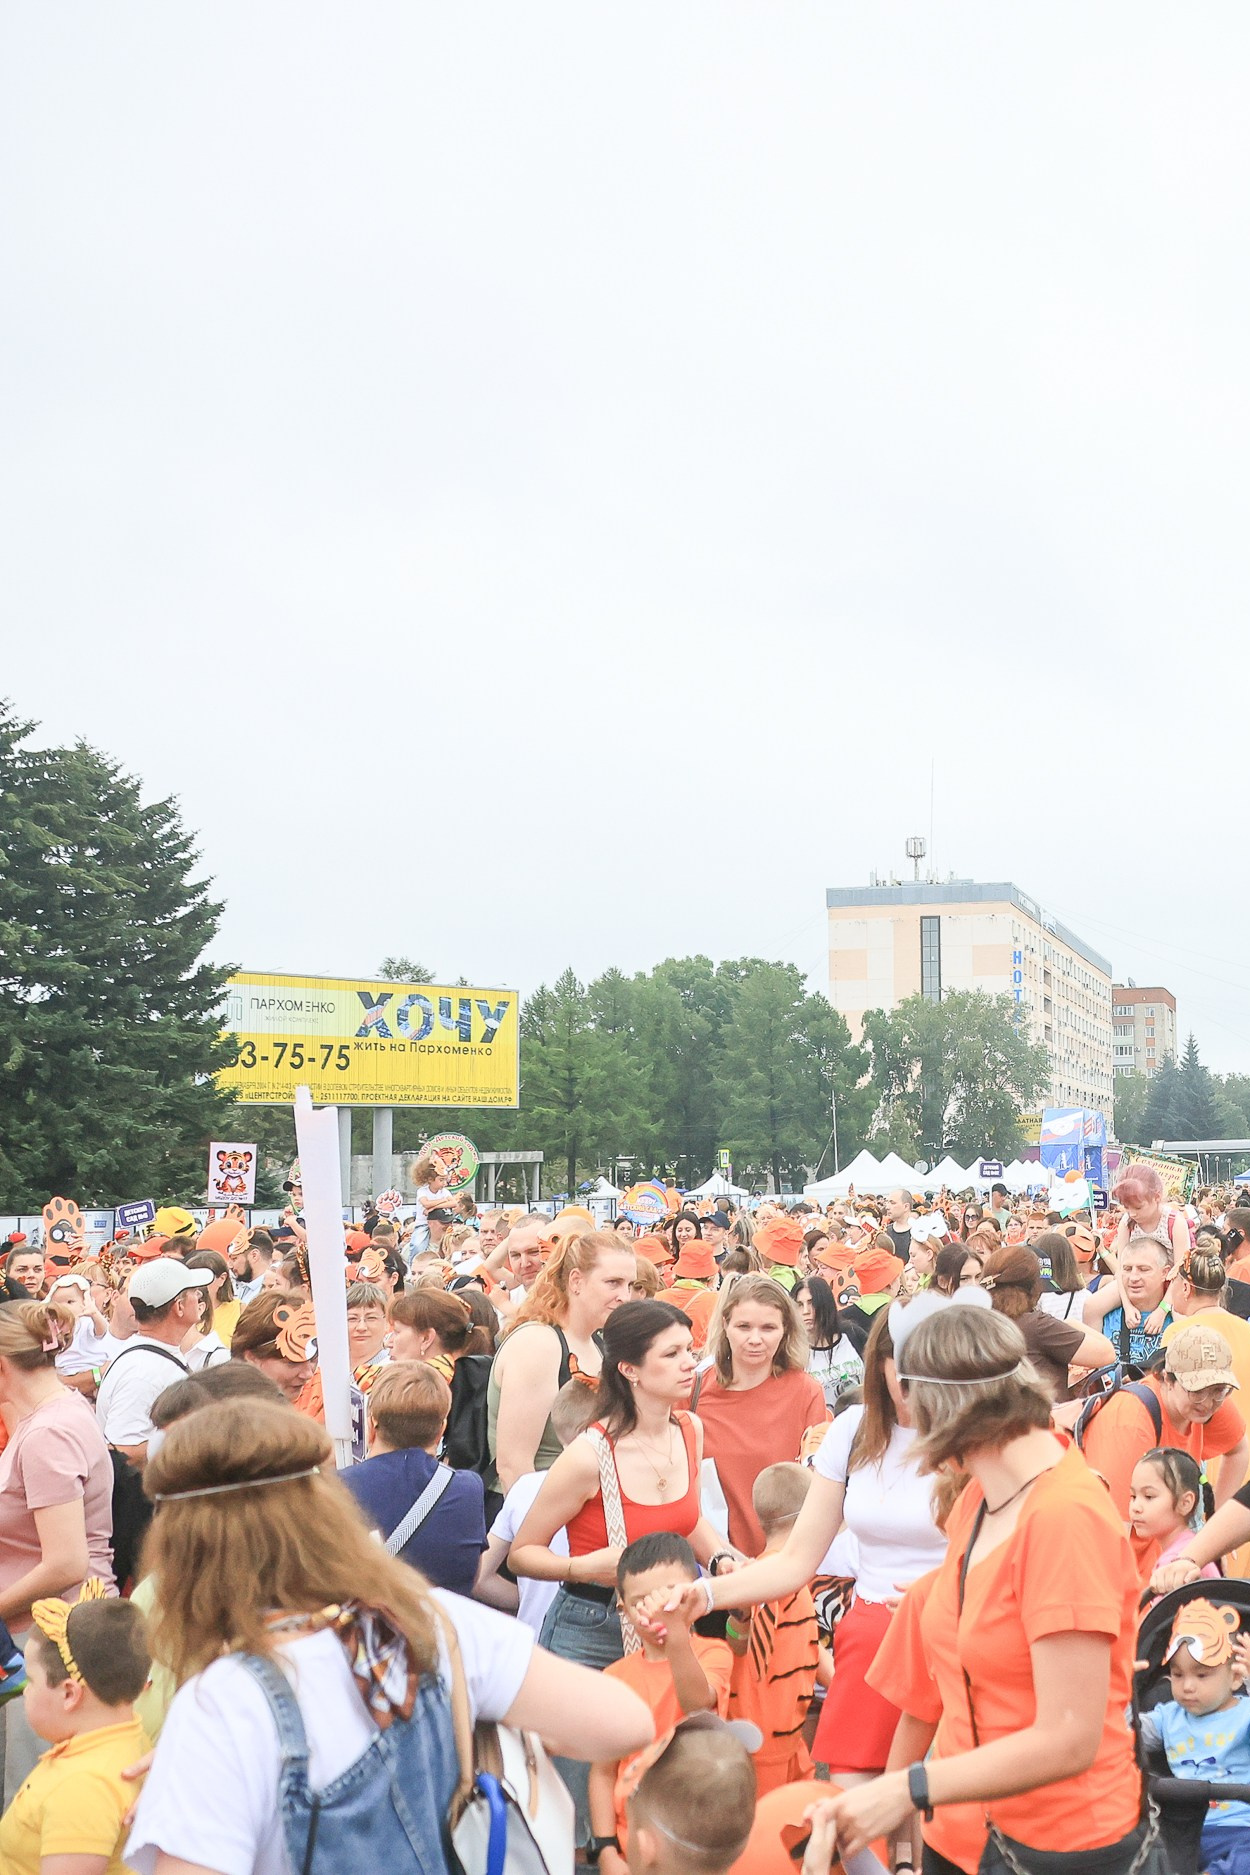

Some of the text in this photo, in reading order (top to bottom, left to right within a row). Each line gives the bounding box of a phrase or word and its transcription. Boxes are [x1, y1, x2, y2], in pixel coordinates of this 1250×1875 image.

[250, 998, 335, 1014] ПАРХОМЕНКО
[355, 991, 510, 1043] ХОЧУ
[390, 1043, 406, 1052] на
[410, 1042, 492, 1056] Пархоменко
[361, 1093, 397, 1101] ПРОЕКТНАЯ
[398, 1094, 440, 1102] ДЕКЛАРАЦИЯ
[452, 1094, 471, 1102] САЙТЕ
